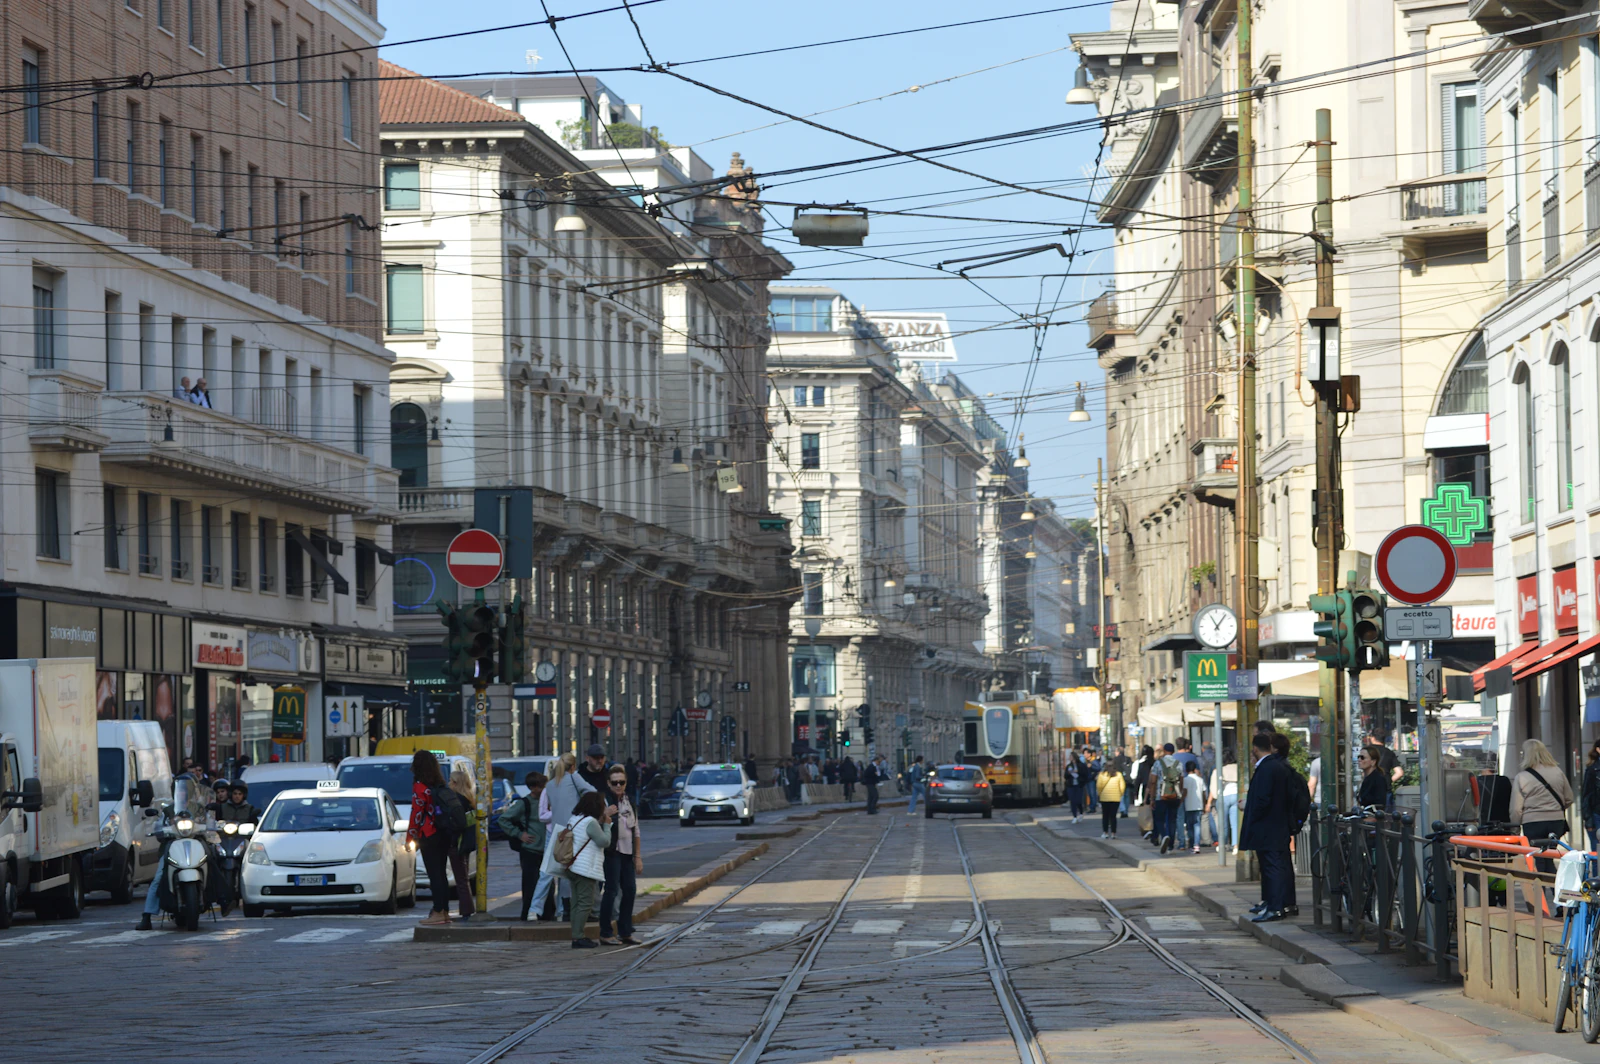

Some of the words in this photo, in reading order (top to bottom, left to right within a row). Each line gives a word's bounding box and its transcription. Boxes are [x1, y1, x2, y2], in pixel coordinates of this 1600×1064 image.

[720, 474, 735, 484] 195
[1403, 610, 1433, 618] eccetto
[1451, 613, 1497, 631] taura
